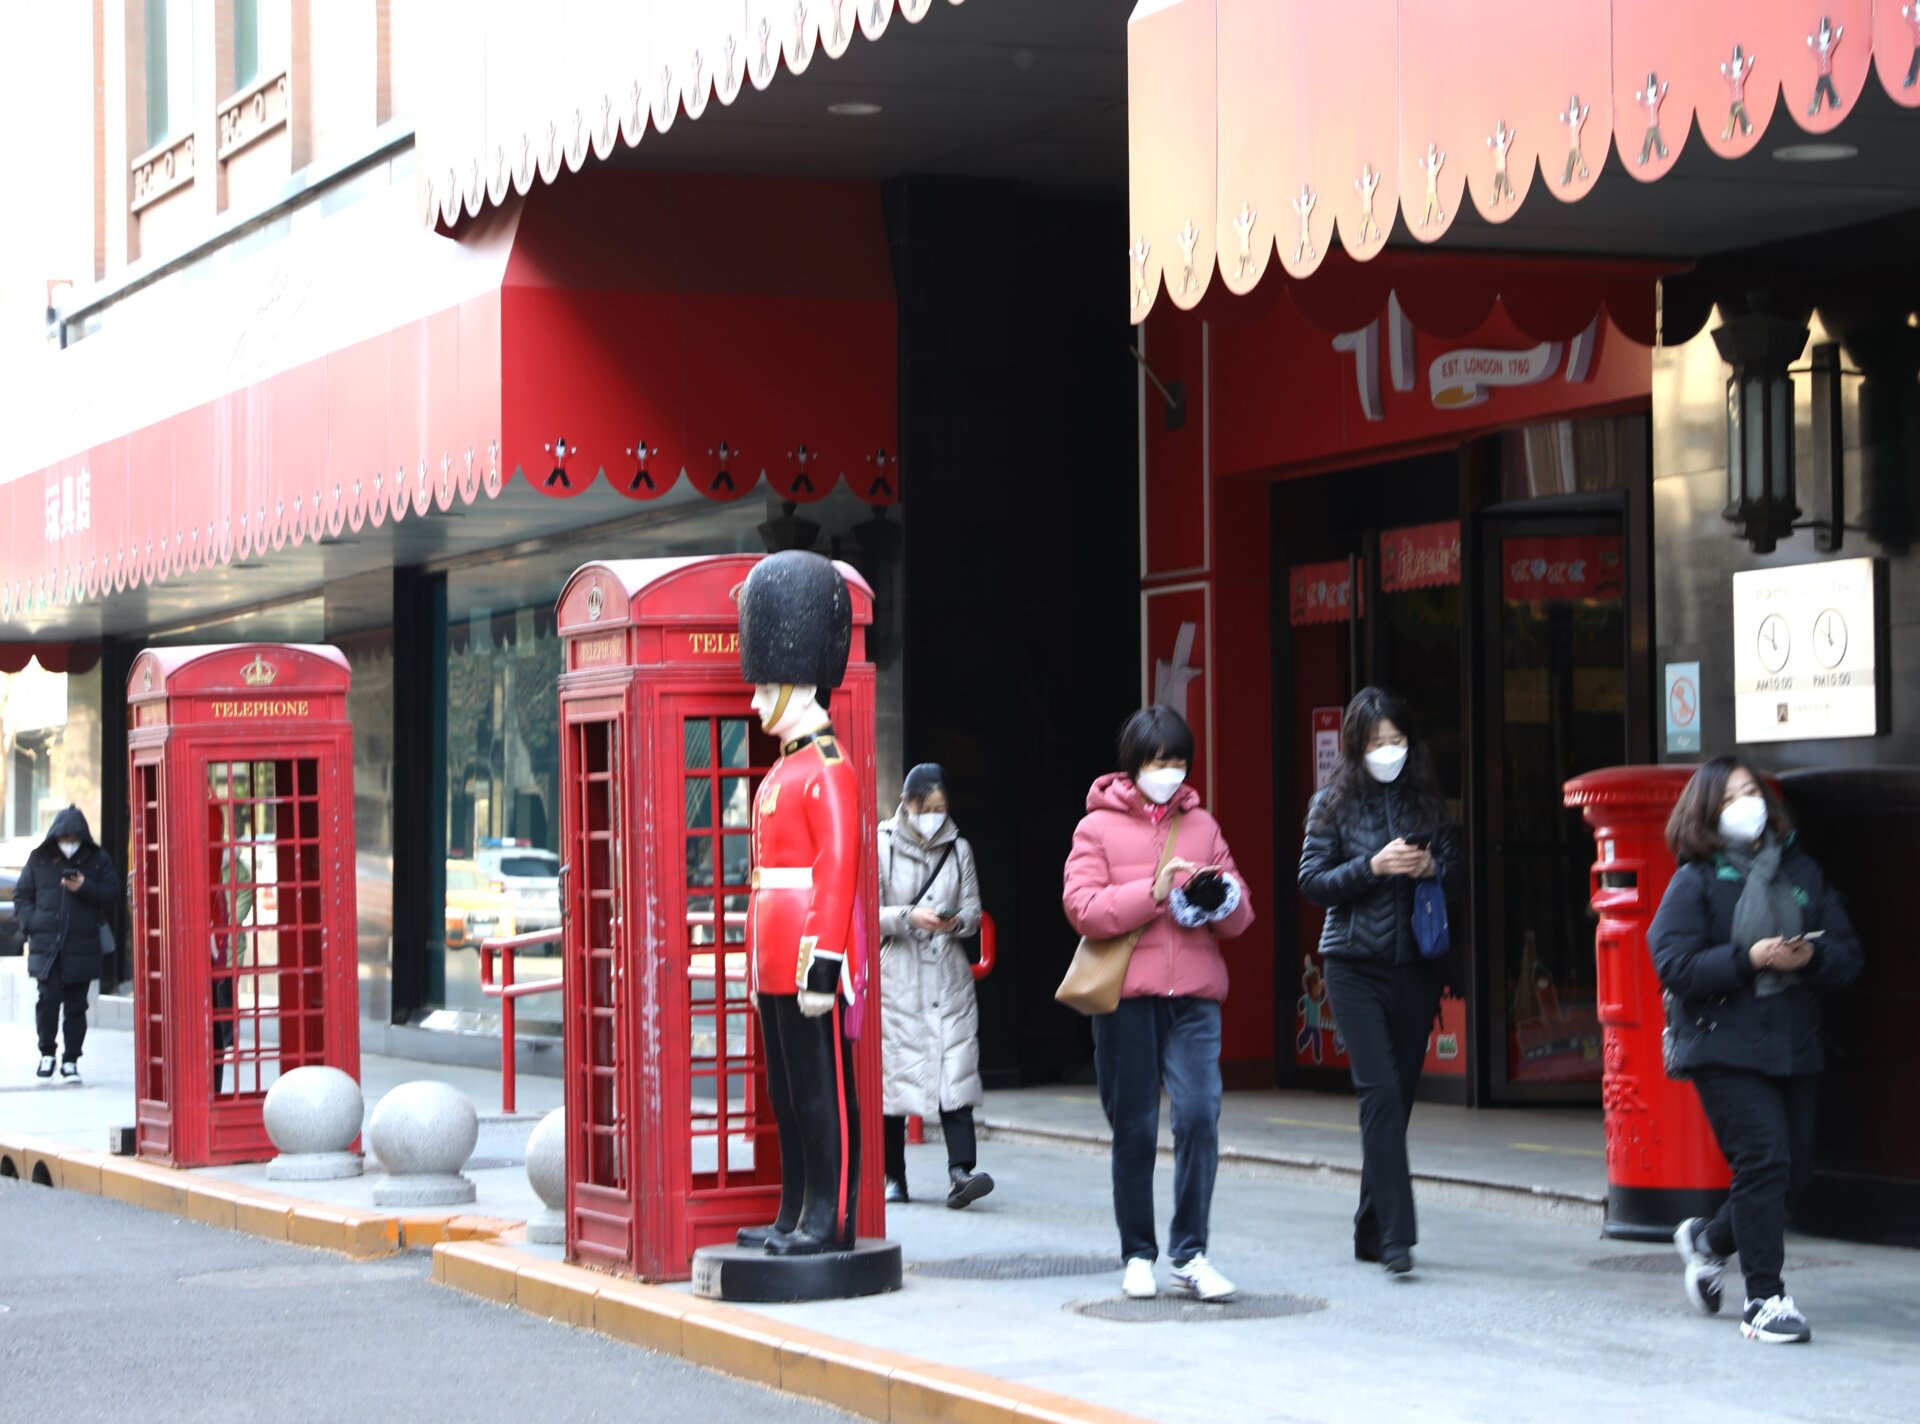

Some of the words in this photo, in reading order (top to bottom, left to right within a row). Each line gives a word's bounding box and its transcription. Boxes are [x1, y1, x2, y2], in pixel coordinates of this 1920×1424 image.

[1464, 357, 1503, 375] LONDON
[45, 468, 91, 543] 玩具店
[212, 700, 308, 719] TELEPHONE
